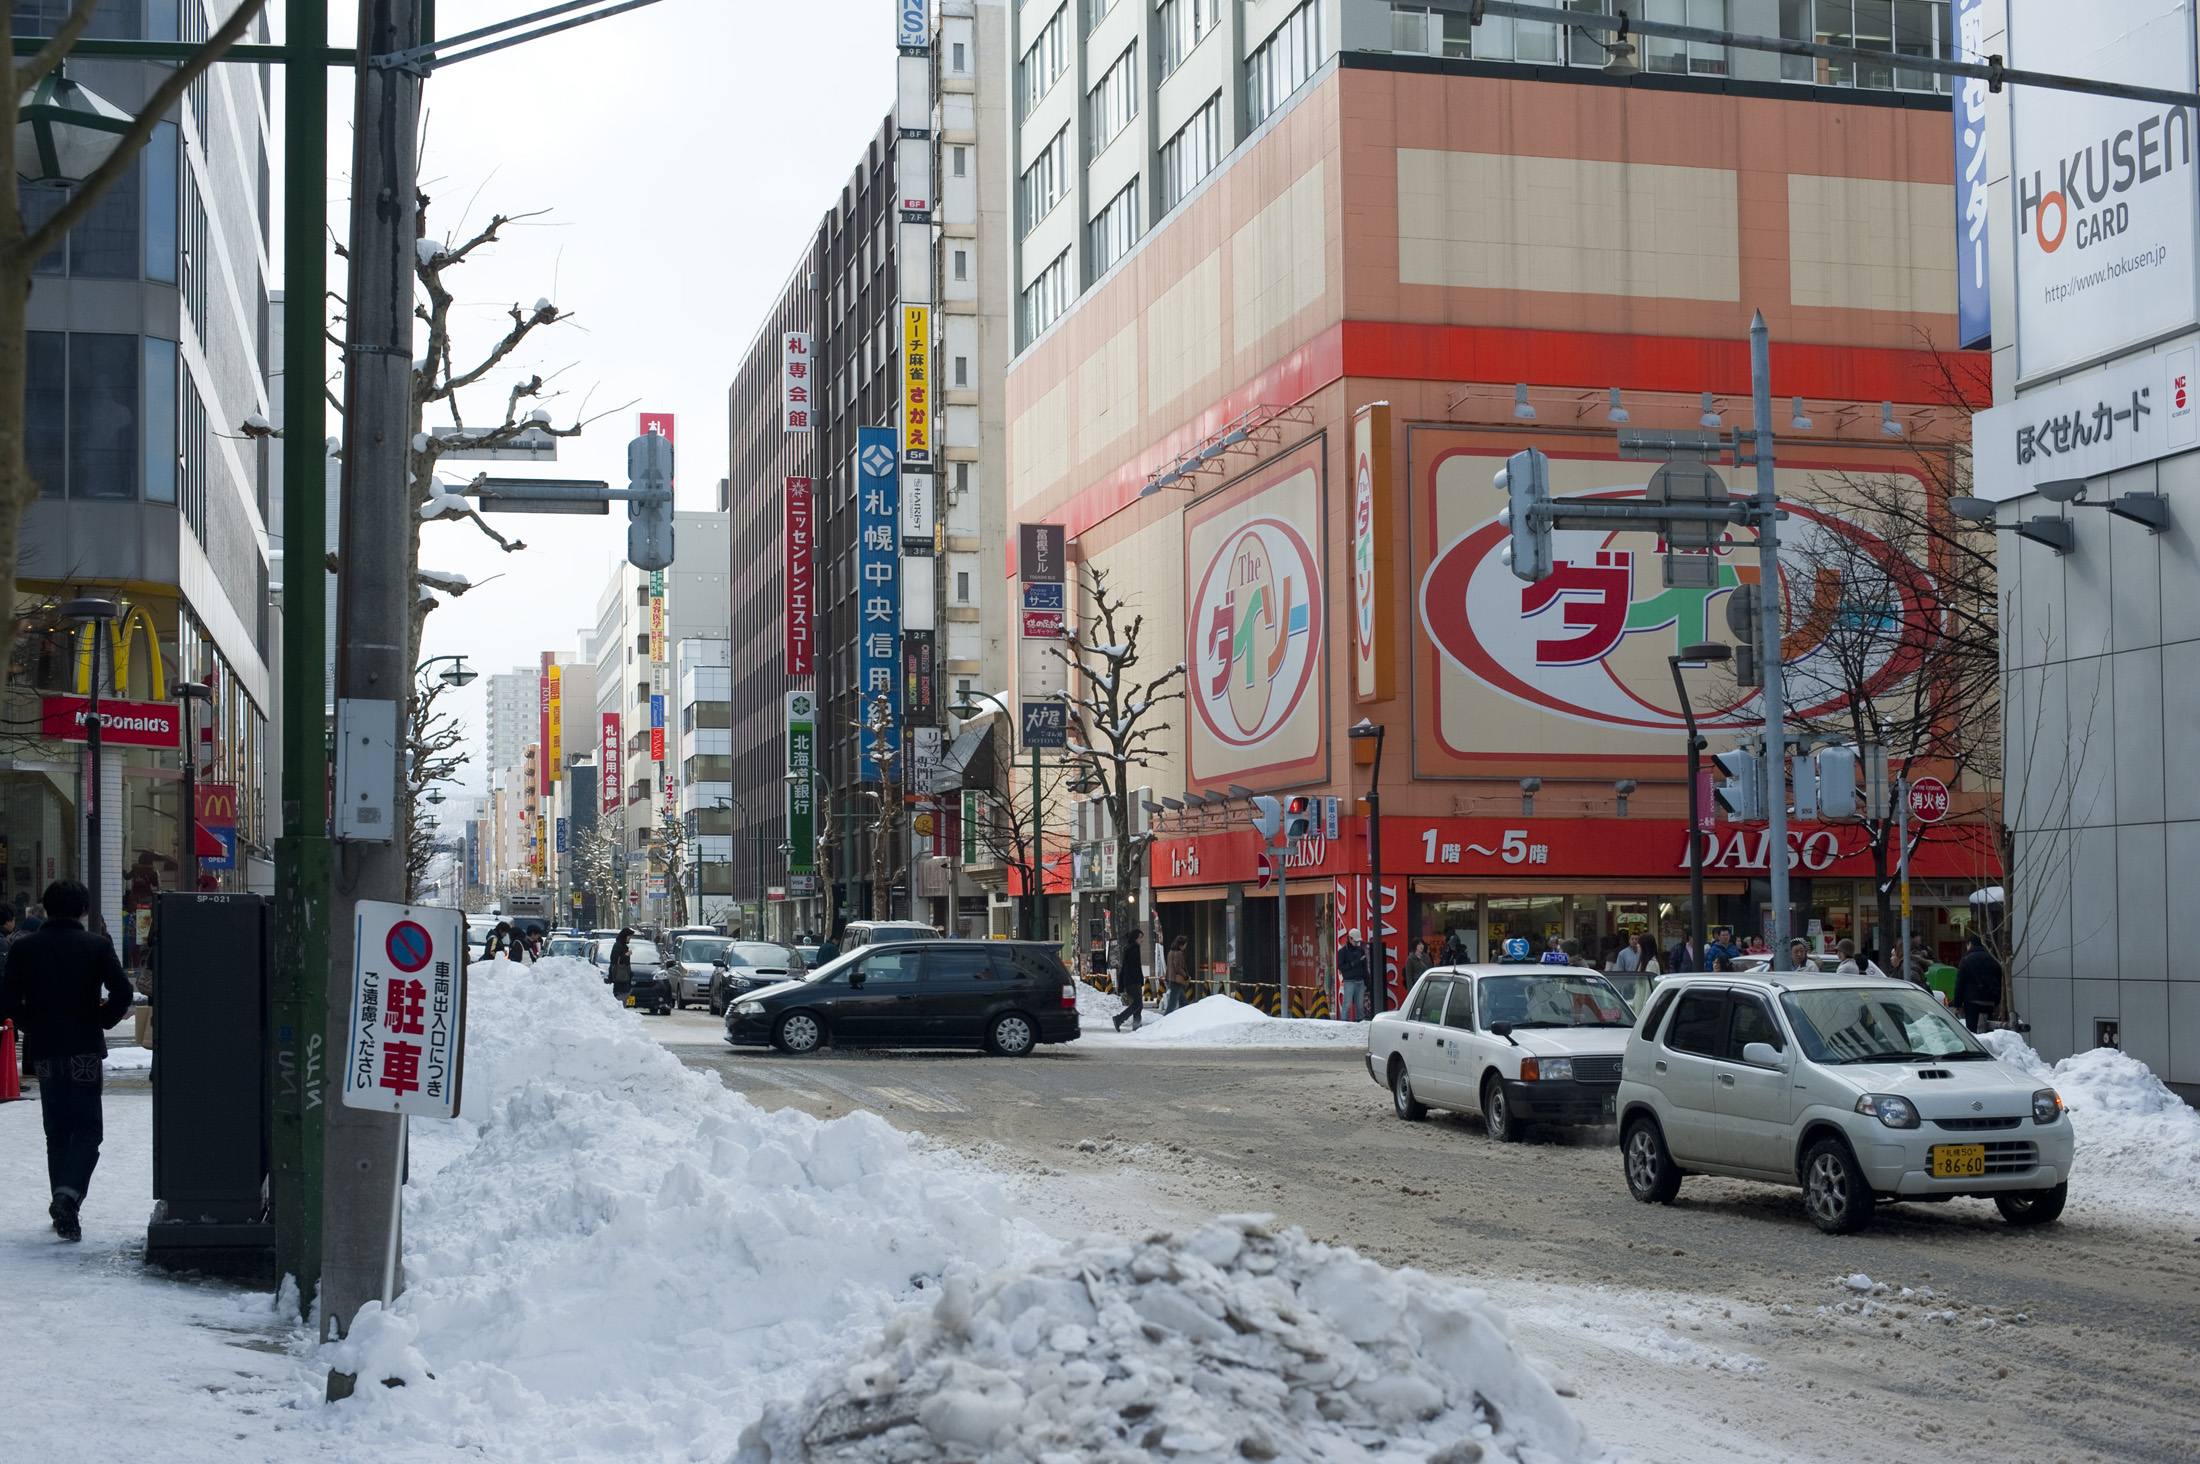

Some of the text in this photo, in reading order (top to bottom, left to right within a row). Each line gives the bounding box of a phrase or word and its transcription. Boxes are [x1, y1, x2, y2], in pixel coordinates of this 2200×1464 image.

[900, 33, 926, 44] ビル
[2076, 201, 2129, 250] CARD
[2044, 243, 2167, 304] http://www.hokusen.jp
[909, 310, 925, 381] リーチ麻雀
[788, 337, 808, 427] 札専会館
[2174, 375, 2186, 390] NC
[909, 386, 926, 446] さかえ
[2016, 387, 2151, 465] ほくせんカード
[909, 451, 925, 459] 5F
[1238, 551, 1261, 587] The
[1357, 495, 1371, 631] ダイソー
[791, 502, 806, 673] ニッセンレンエスコート
[1029, 596, 1059, 607] サーズ
[1208, 575, 1309, 701] ダイソー
[75, 711, 169, 733] MDonald's
[1026, 706, 1060, 732] 大戸屋
[665, 775, 674, 814] リオネット
[1912, 792, 1946, 810] 消火栓
[1679, 829, 1839, 870] DAISO
[197, 895, 231, 903] SP-021
[356, 971, 379, 1089] ご遠慮ください
[379, 978, 427, 1097] 駐車
[427, 961, 450, 1097] 車両出入口につき
[1945, 1158, 1982, 1173] 86-60
